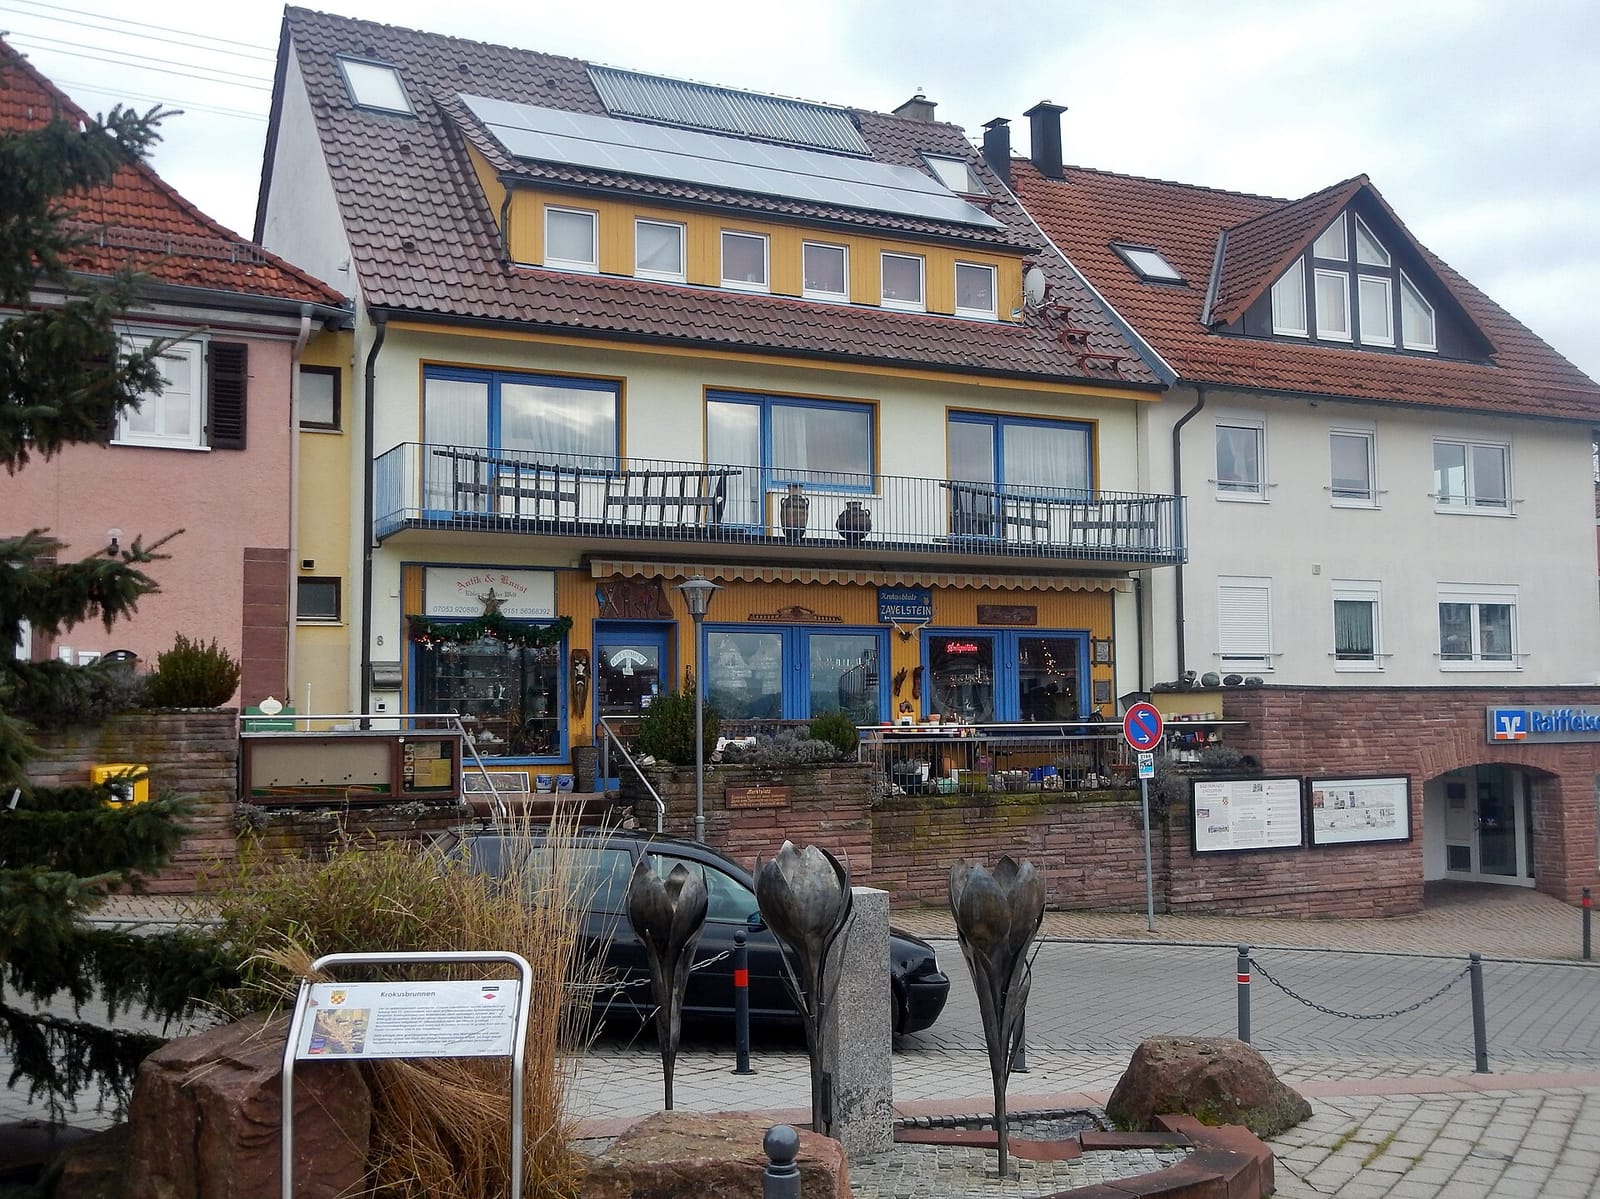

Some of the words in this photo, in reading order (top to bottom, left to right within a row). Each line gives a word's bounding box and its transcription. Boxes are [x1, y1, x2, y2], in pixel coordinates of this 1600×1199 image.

[456, 575, 481, 592] Antik
[484, 574, 496, 583] &
[500, 574, 528, 594] Kunst
[881, 605, 931, 616] ZAVELSTEIN
[377, 635, 384, 647] 8
